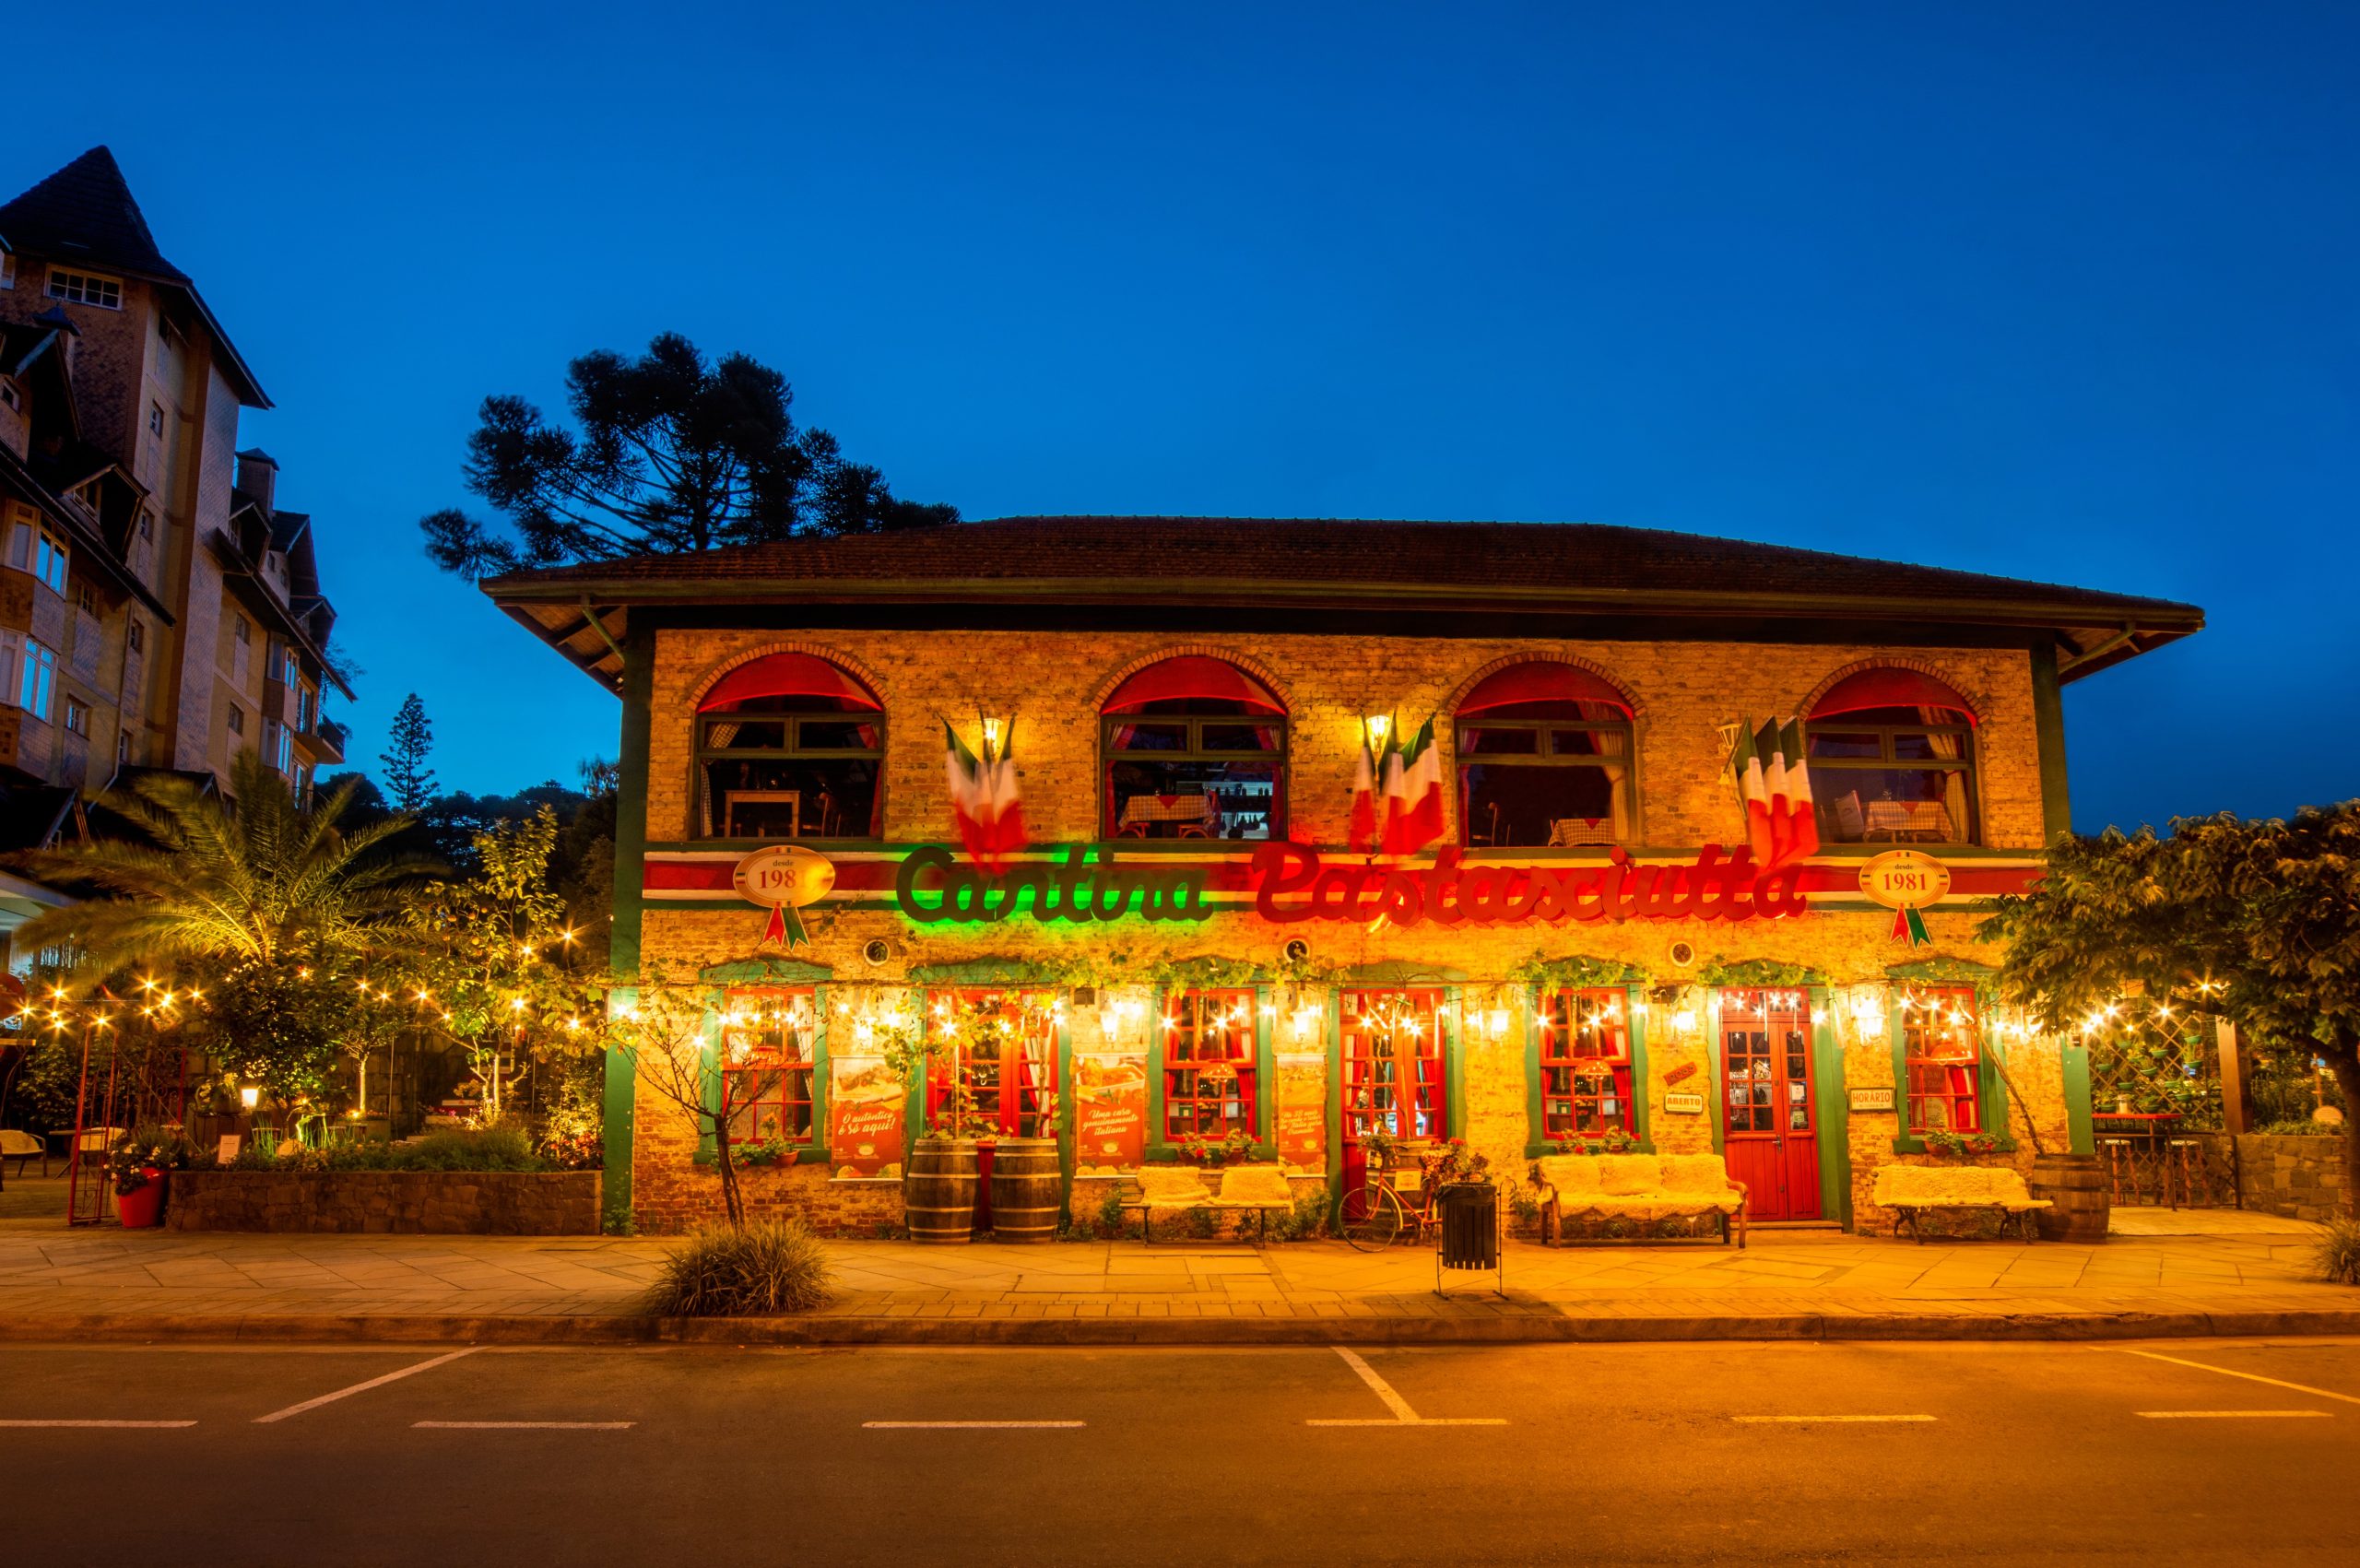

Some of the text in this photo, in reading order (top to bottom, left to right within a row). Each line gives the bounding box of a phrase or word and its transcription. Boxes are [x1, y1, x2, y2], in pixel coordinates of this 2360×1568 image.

[759, 869, 806, 889] 198
[896, 841, 1807, 924] Cantina Pastasciutta
[1883, 872, 1926, 890] 1981
[1667, 1097, 1701, 1106] ABERTO
[843, 1113, 852, 1124] O
[1088, 1108, 1131, 1119] Uma casa
[862, 1117, 896, 1137] aqui!
[1082, 1114, 1139, 1133] genuinamente
[1093, 1126, 1127, 1136] italiana
